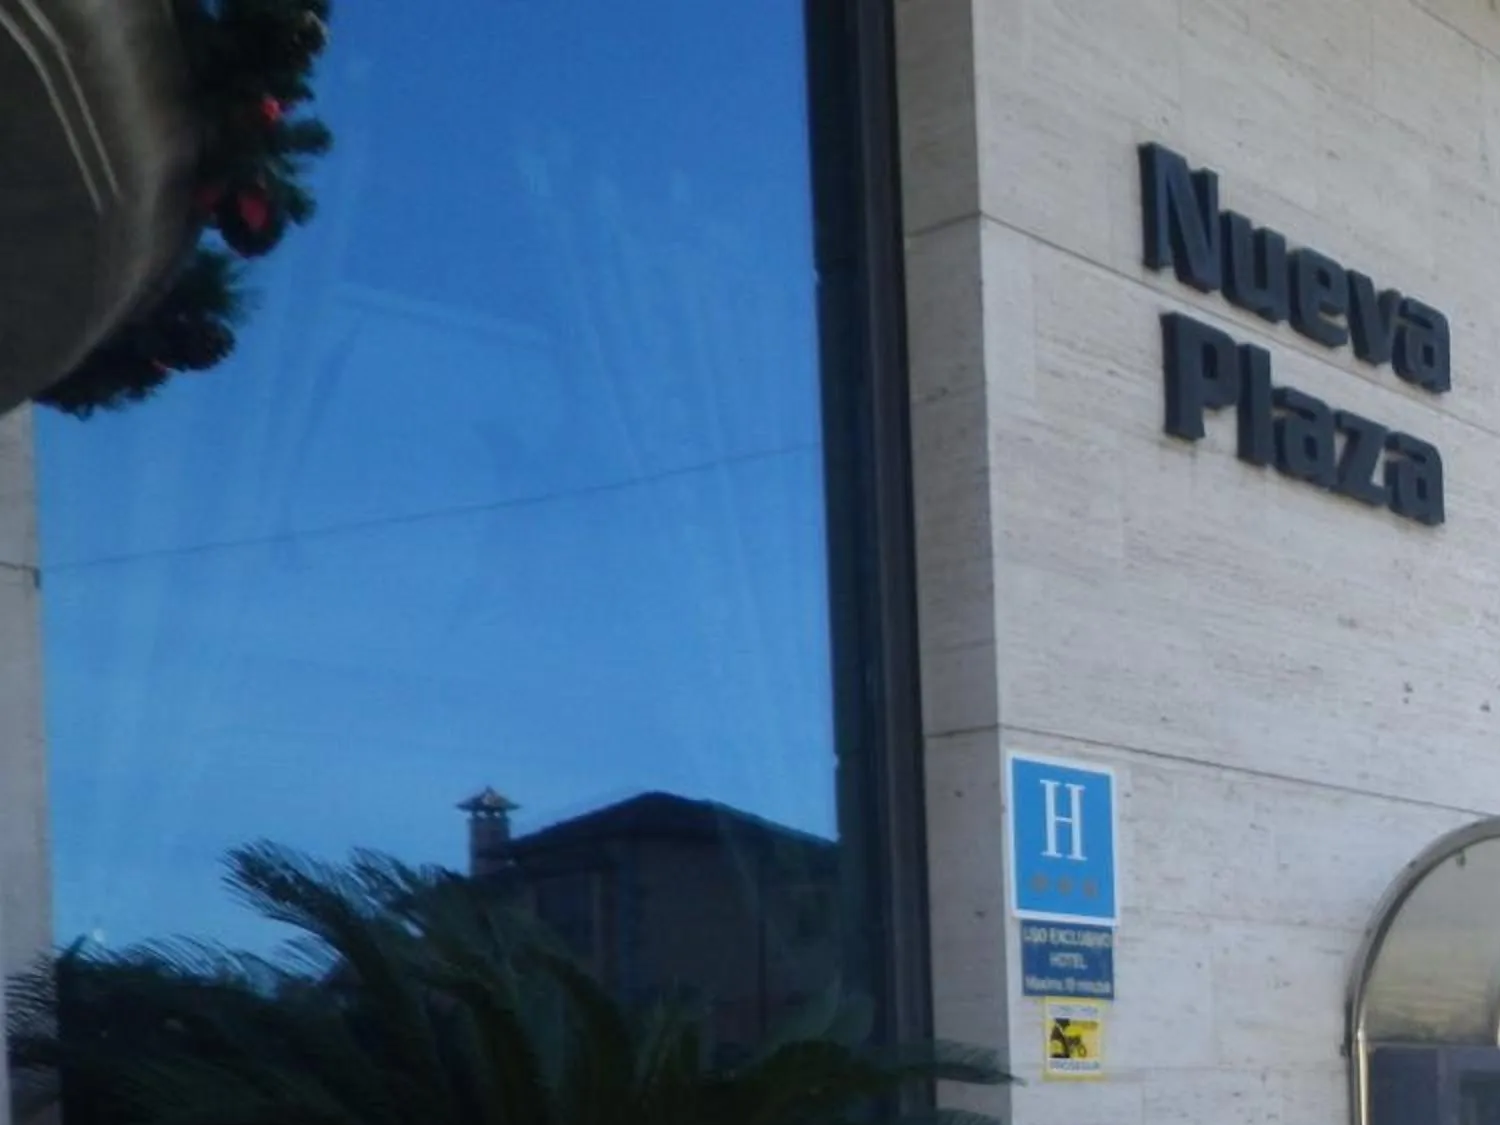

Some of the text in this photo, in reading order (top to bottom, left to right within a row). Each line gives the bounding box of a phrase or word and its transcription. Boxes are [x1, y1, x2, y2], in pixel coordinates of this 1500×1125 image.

[1138, 142, 1451, 393] Nueva
[1159, 311, 1445, 526] Plaza
[1039, 778, 1087, 861] H
